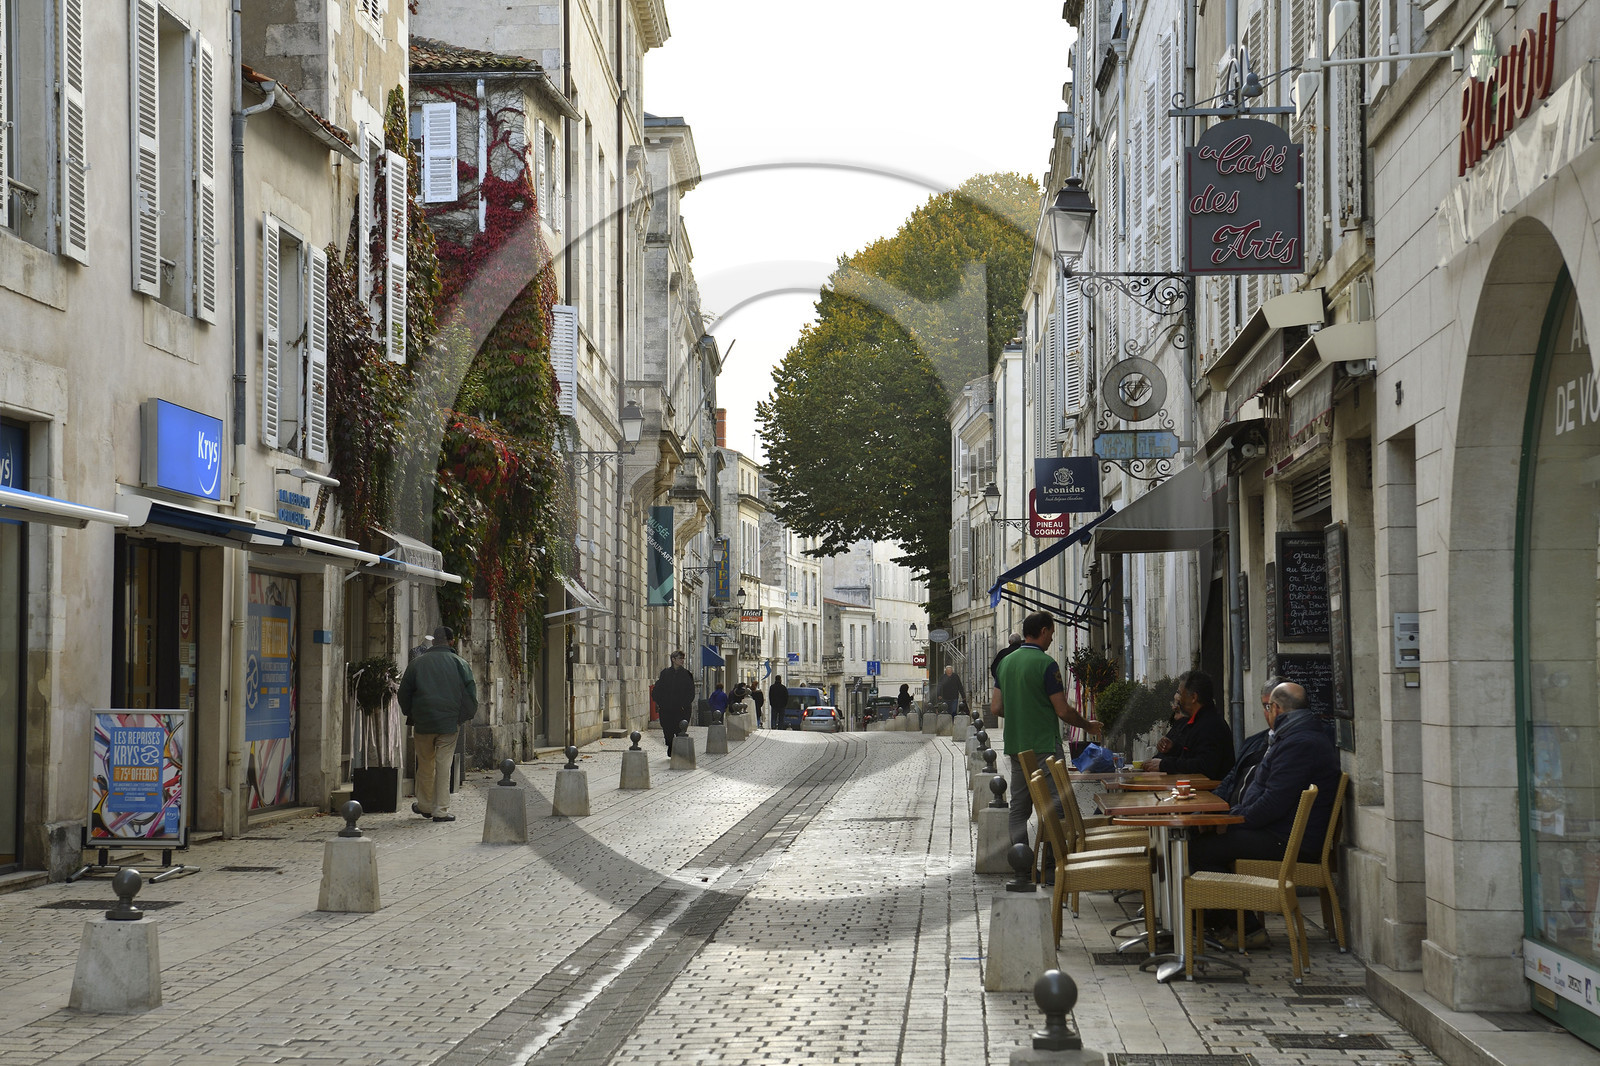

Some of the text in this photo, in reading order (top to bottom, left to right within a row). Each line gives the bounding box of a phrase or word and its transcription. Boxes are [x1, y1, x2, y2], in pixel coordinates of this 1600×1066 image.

[1458, 0, 1558, 177] RICHOU
[1199, 134, 1288, 181] Café
[1189, 184, 1240, 214] des
[1211, 219, 1297, 264] Arts
[1555, 379, 1576, 436] DE
[198, 431, 218, 469] Krys
[1043, 485, 1085, 494] Leonidas
[647, 516, 670, 539] MUSÉE
[647, 535, 674, 566] BEAUX-ARTS
[743, 609, 762, 617] Hôtel
[114, 731, 160, 745] LES REPRISES
[113, 745, 140, 766] KRYS
[131, 767, 158, 781] OFFERTS
